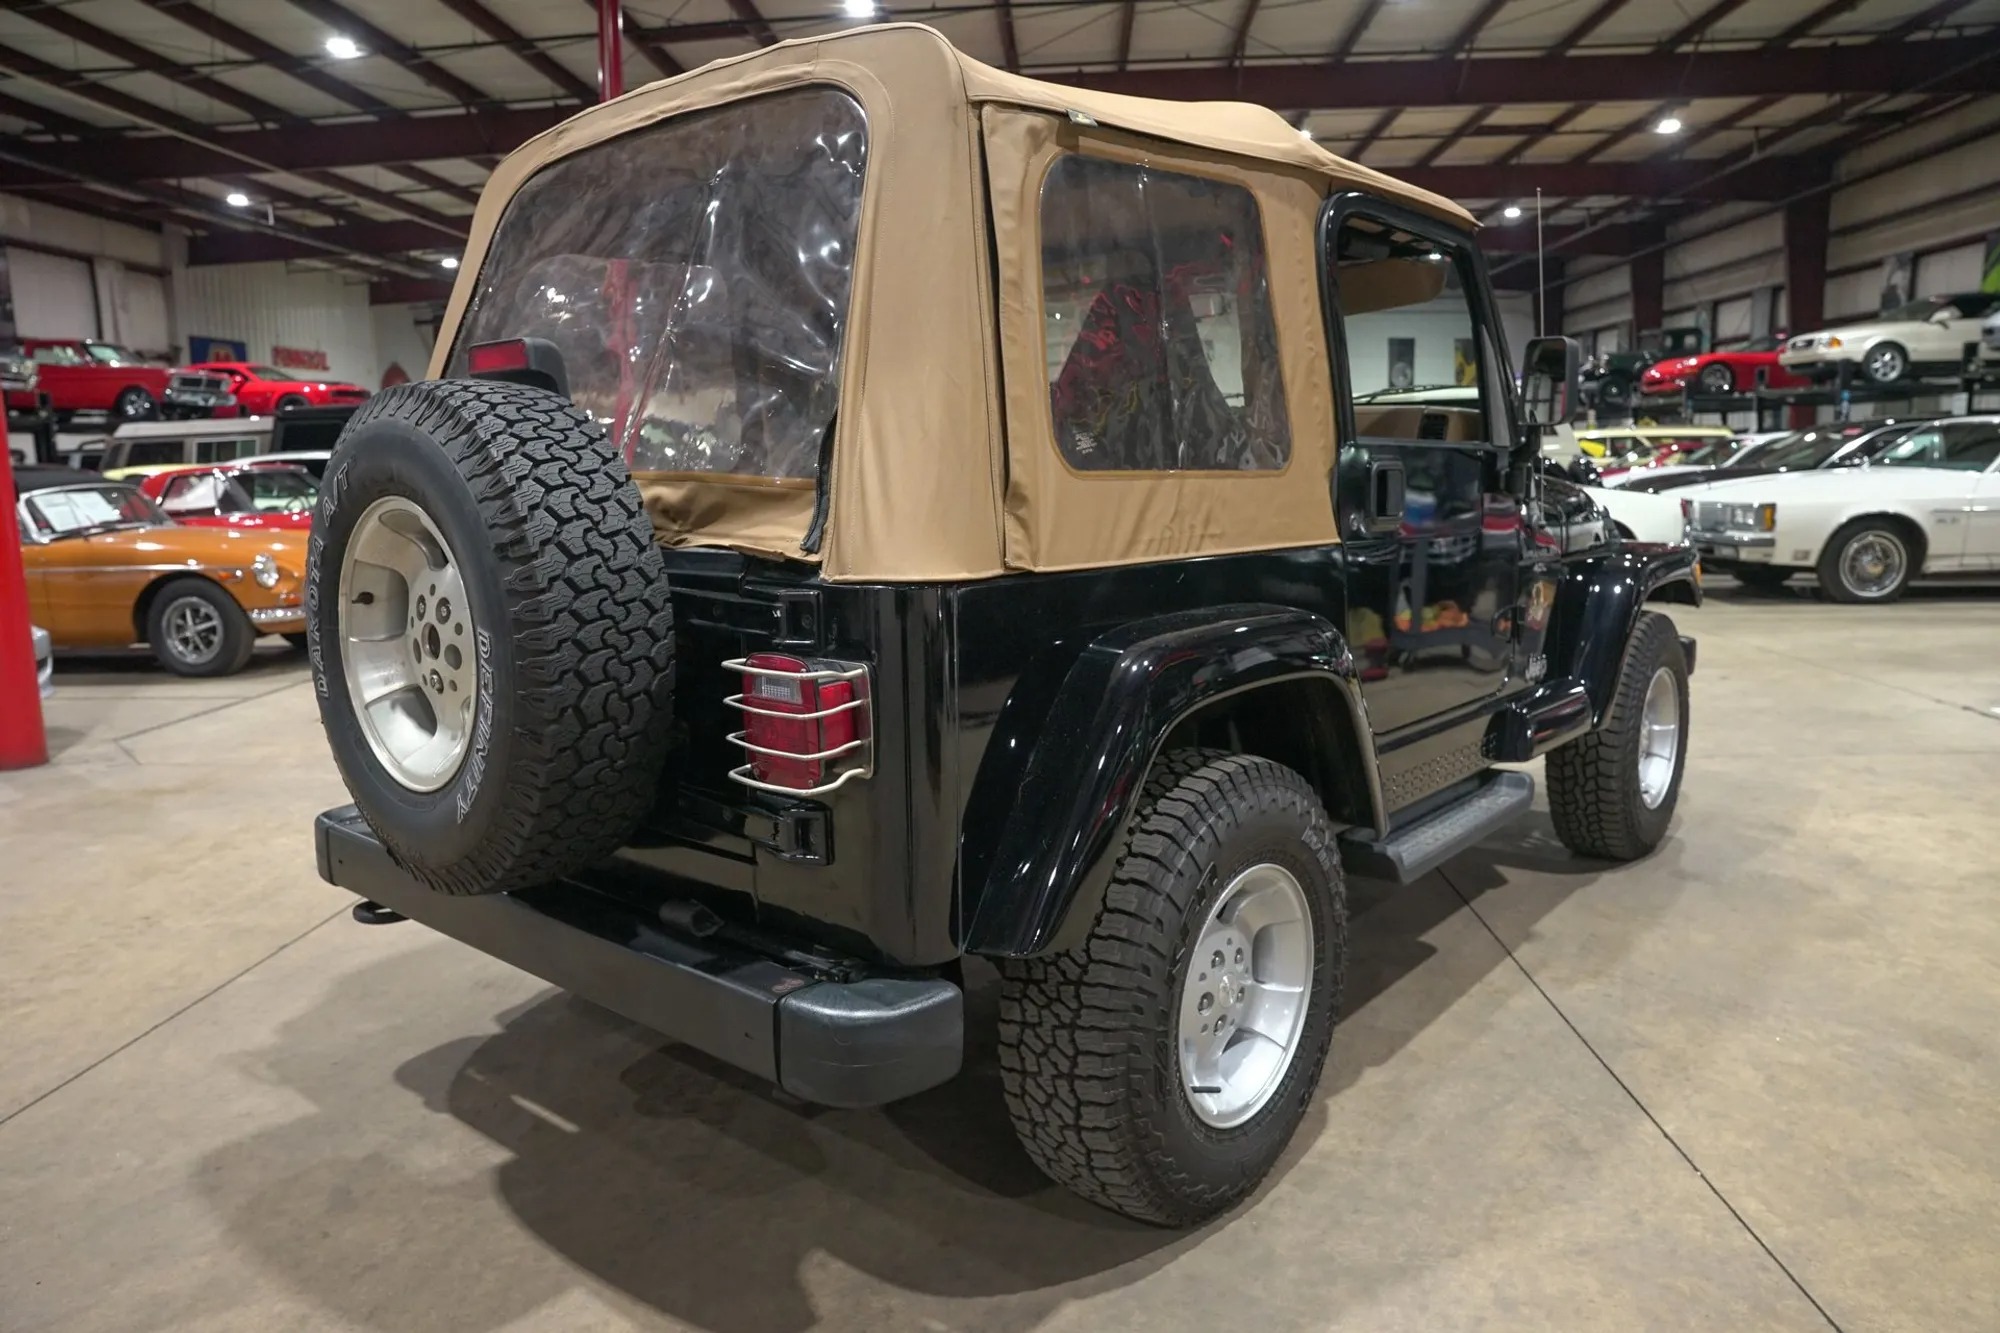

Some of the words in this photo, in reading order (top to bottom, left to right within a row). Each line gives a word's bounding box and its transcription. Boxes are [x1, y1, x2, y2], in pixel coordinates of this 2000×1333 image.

[308, 535, 330, 699] DAKOTA
[322, 462, 348, 528] A/T
[456, 627, 495, 825] DEFINITY
